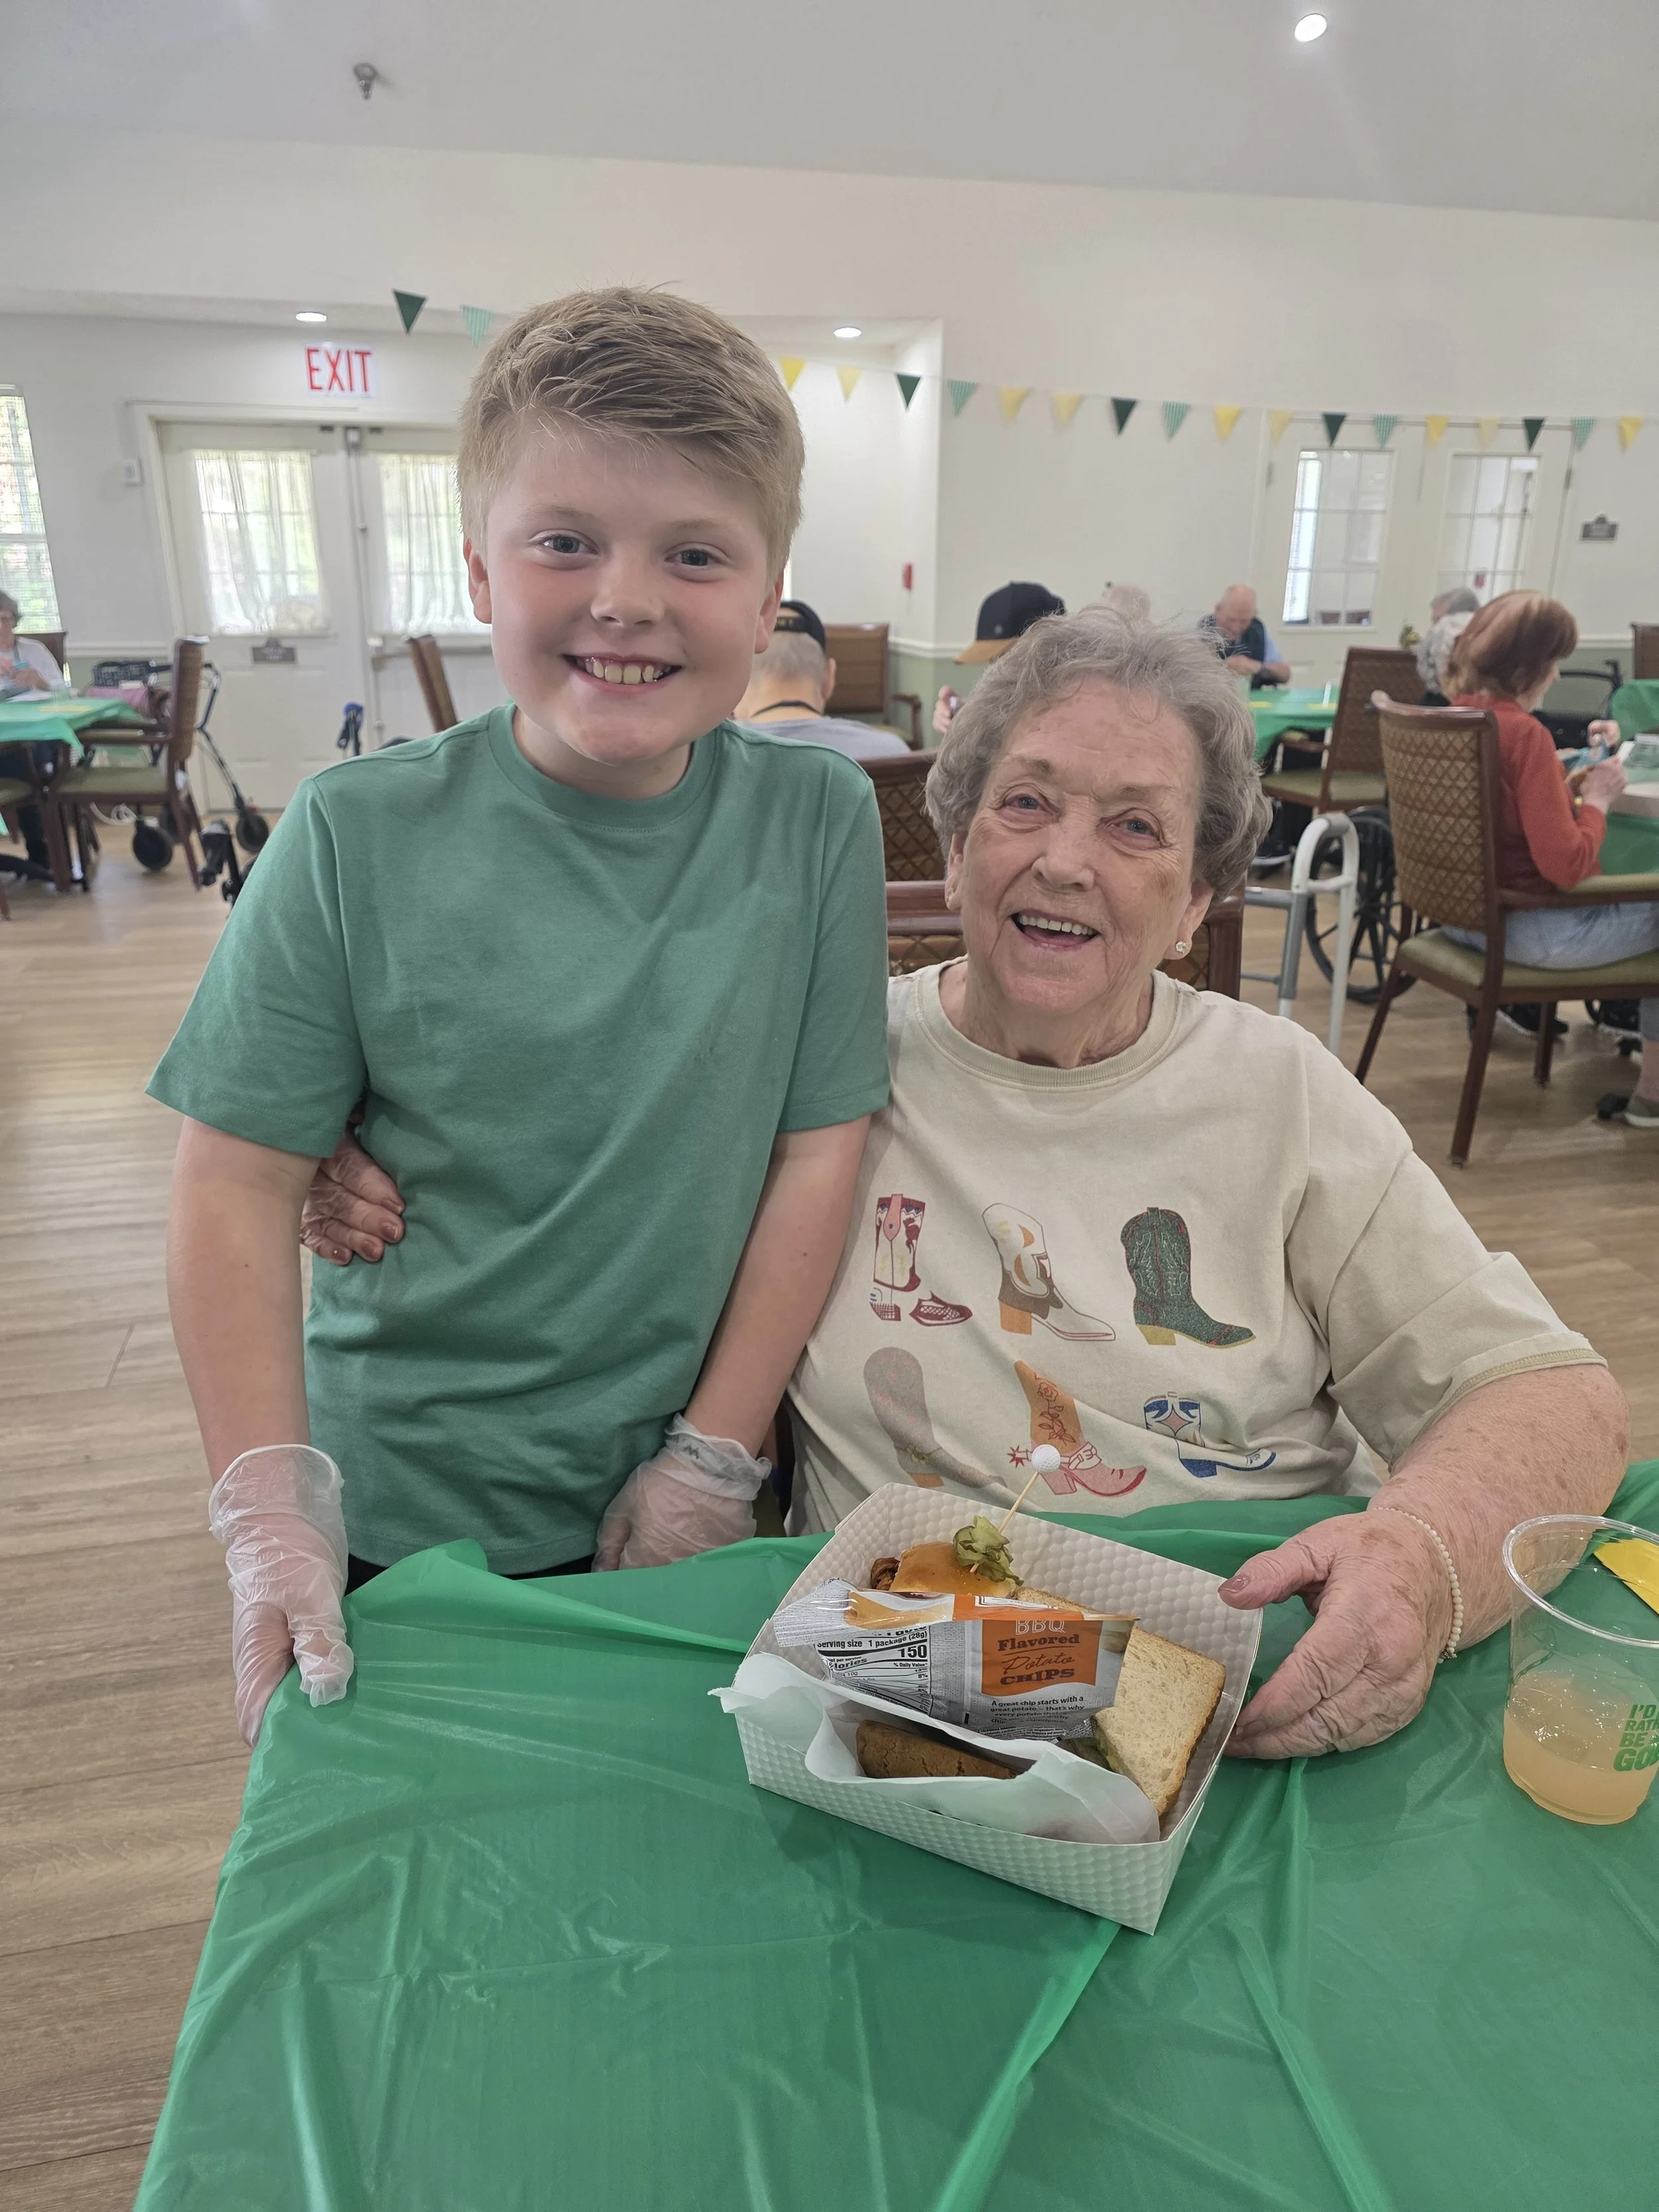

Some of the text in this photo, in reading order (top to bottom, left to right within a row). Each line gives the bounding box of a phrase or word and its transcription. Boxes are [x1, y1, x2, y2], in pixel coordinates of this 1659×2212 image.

[306, 348, 372, 392] EXIT
[1015, 1619, 1066, 1635] BBQ
[875, 1636, 906, 1648] package
[908, 1631, 928, 1641] (28g)
[997, 1634, 1080, 1652] Flavored
[833, 1658, 868, 1669] lories
[897, 1644, 928, 1659] 150
[1001, 1652, 1075, 1674] Potato
[1000, 1668, 1075, 1685] CHIPS
[1628, 1704, 1657, 1719] I'D
[1619, 1732, 1648, 1747] BE
